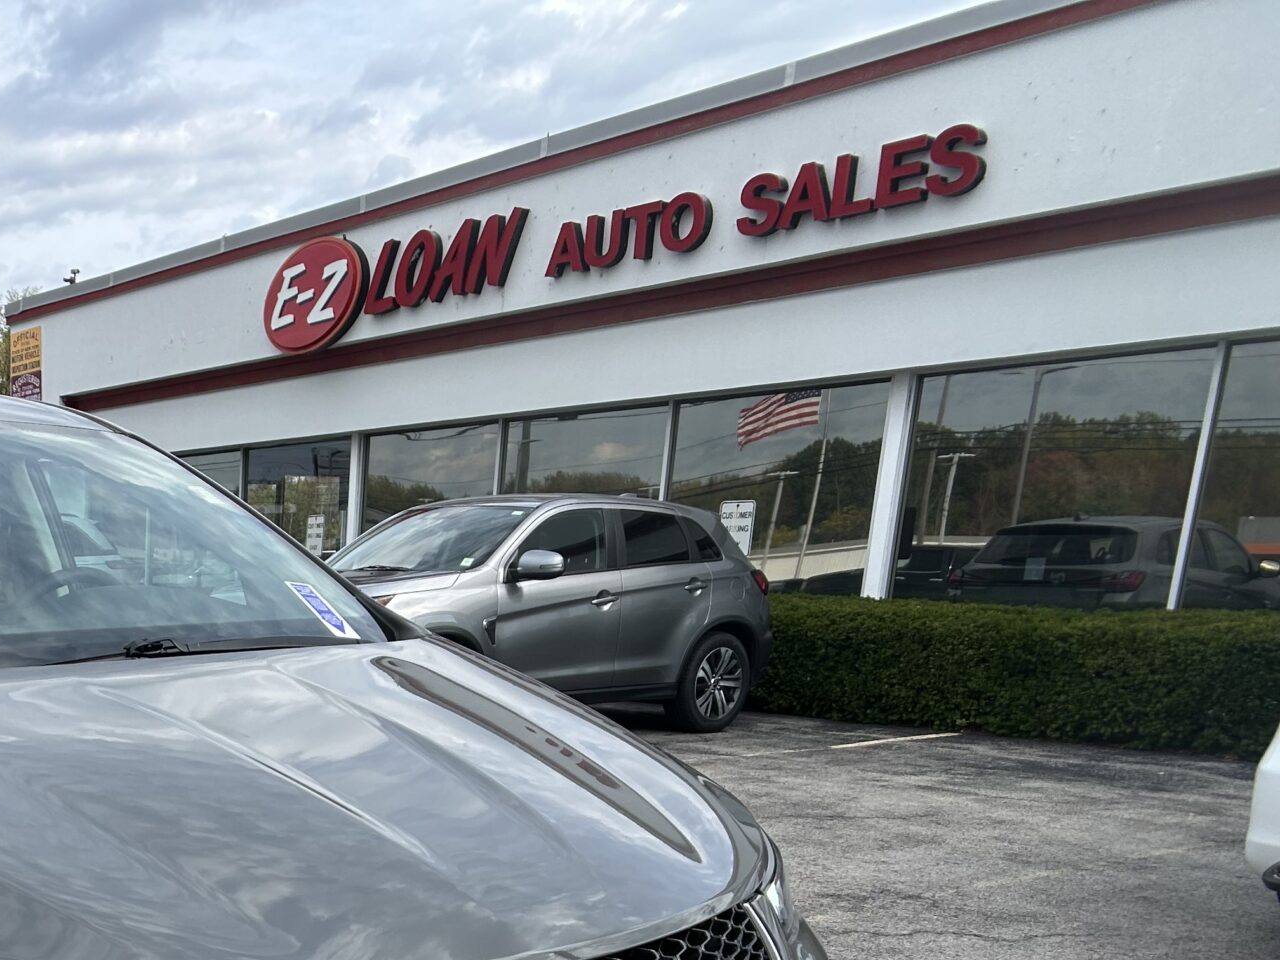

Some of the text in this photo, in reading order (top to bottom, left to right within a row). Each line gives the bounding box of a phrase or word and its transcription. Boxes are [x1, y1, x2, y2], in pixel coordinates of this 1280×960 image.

[270, 123, 988, 331] E-Z LOAN AUTO SALES
[12, 329, 40, 348] OFFICIAL
[12, 349, 40, 364] MOTOR VEHICLE
[12, 373, 40, 393] REGISTERED
[725, 525, 749, 533] ARKING
